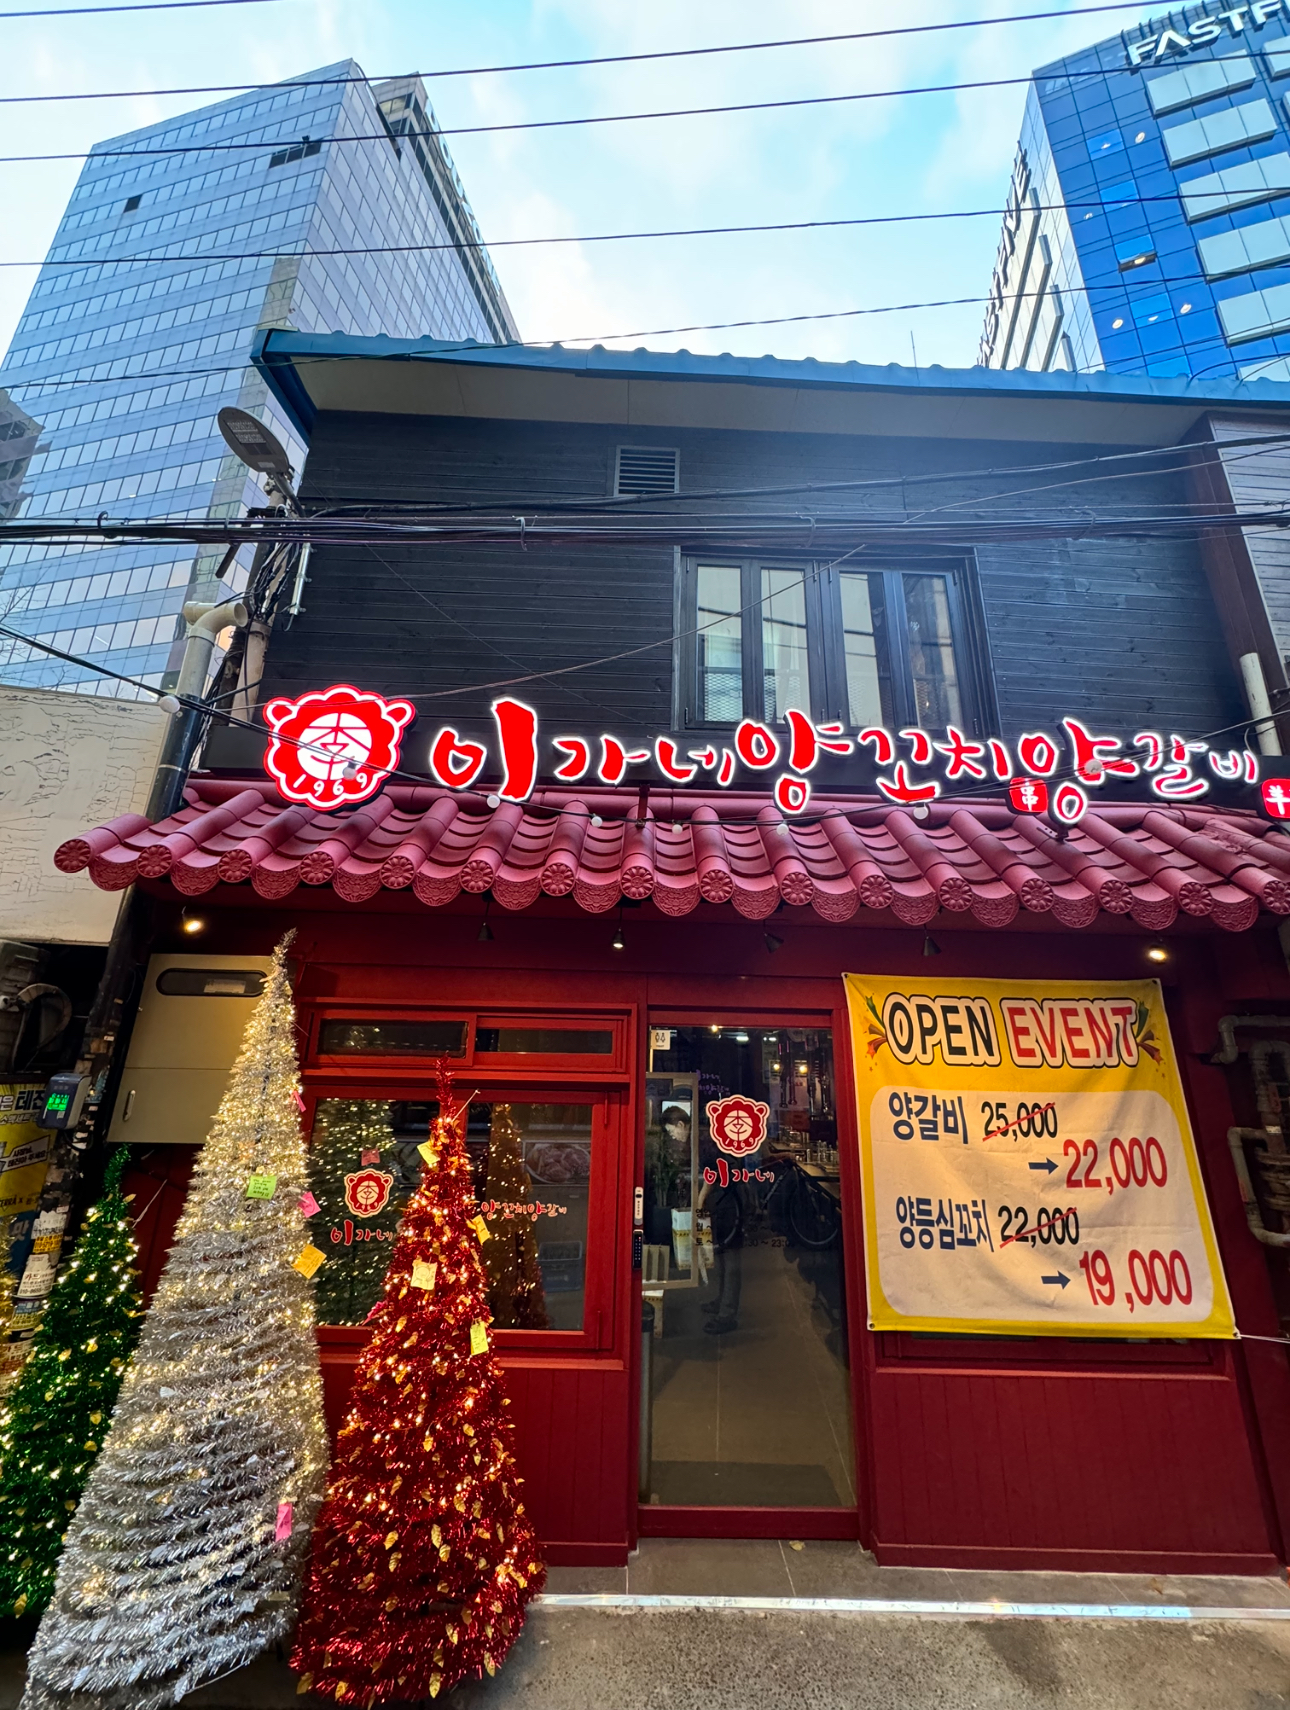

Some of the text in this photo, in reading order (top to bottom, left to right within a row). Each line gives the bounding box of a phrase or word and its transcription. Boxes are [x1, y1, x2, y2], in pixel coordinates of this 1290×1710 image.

[430, 696, 734, 803] 이가네
[293, 773, 367, 797] 1969
[885, 997, 1137, 1063] OPEN EVENT
[725, 1137, 754, 1148] 1969
[888, 1092, 1058, 1144] 양갈비 25,000
[703, 1158, 775, 1188] 이가네
[1063, 1137, 1168, 1195] 22,000
[330, 1219, 393, 1246] 이가네
[895, 1195, 1080, 1252] 양등심꼬치 22,000
[1079, 1248, 1193, 1314] 19,000
